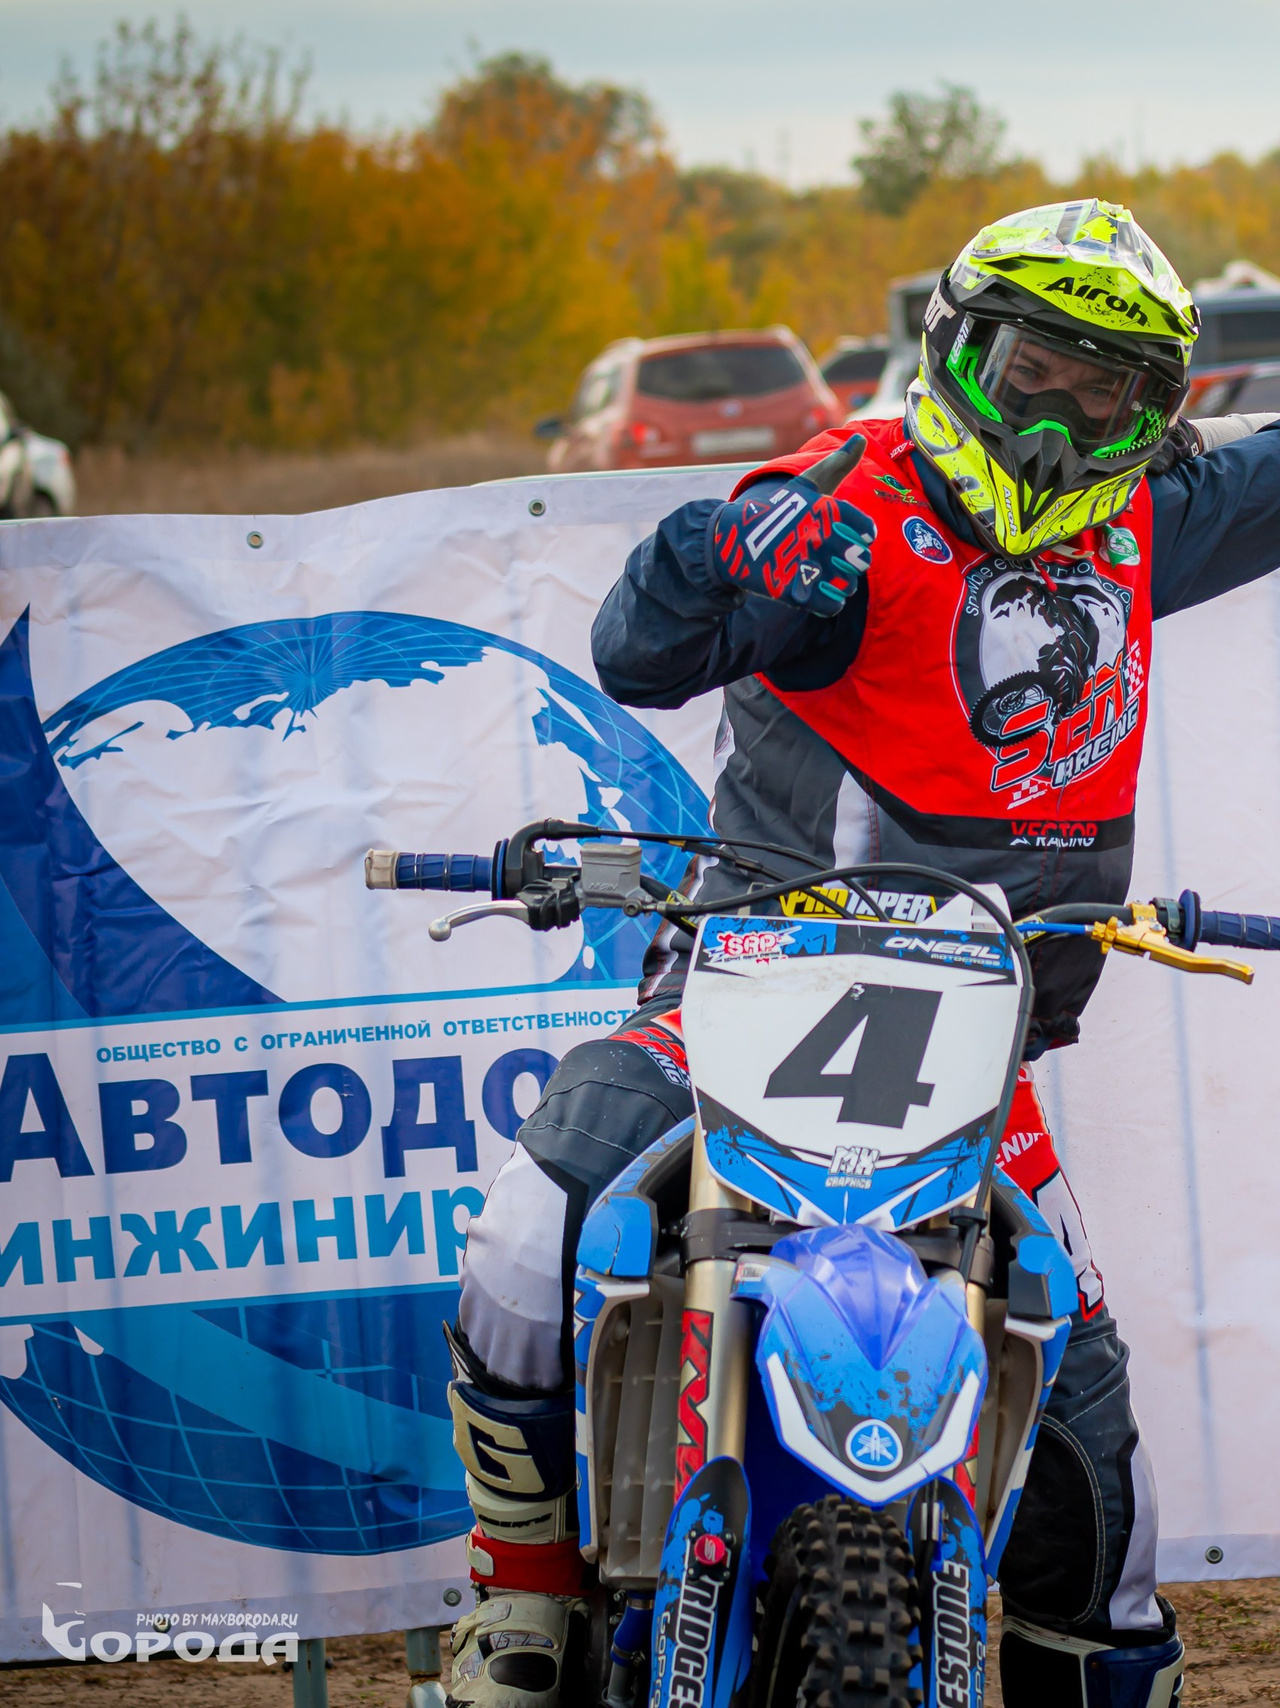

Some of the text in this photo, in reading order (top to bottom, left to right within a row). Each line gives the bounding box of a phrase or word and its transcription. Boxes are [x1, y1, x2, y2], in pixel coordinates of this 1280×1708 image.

[1042, 277, 1150, 328] Airoh
[1002, 484, 1019, 537] Airoh
[1030, 499, 1064, 539] Airoh
[991, 651, 1126, 792] SEM
[1052, 698, 1140, 788] RACING
[96, 1035, 221, 1063] ОБЩЕСТВО
[260, 1020, 432, 1051] ОГРАНИЧЕННОЙ
[443, 1008, 637, 1037] ОТВЕТСТВЕННОСТ
[763, 982, 943, 1129] 4
[829, 1145, 880, 1176] MX
